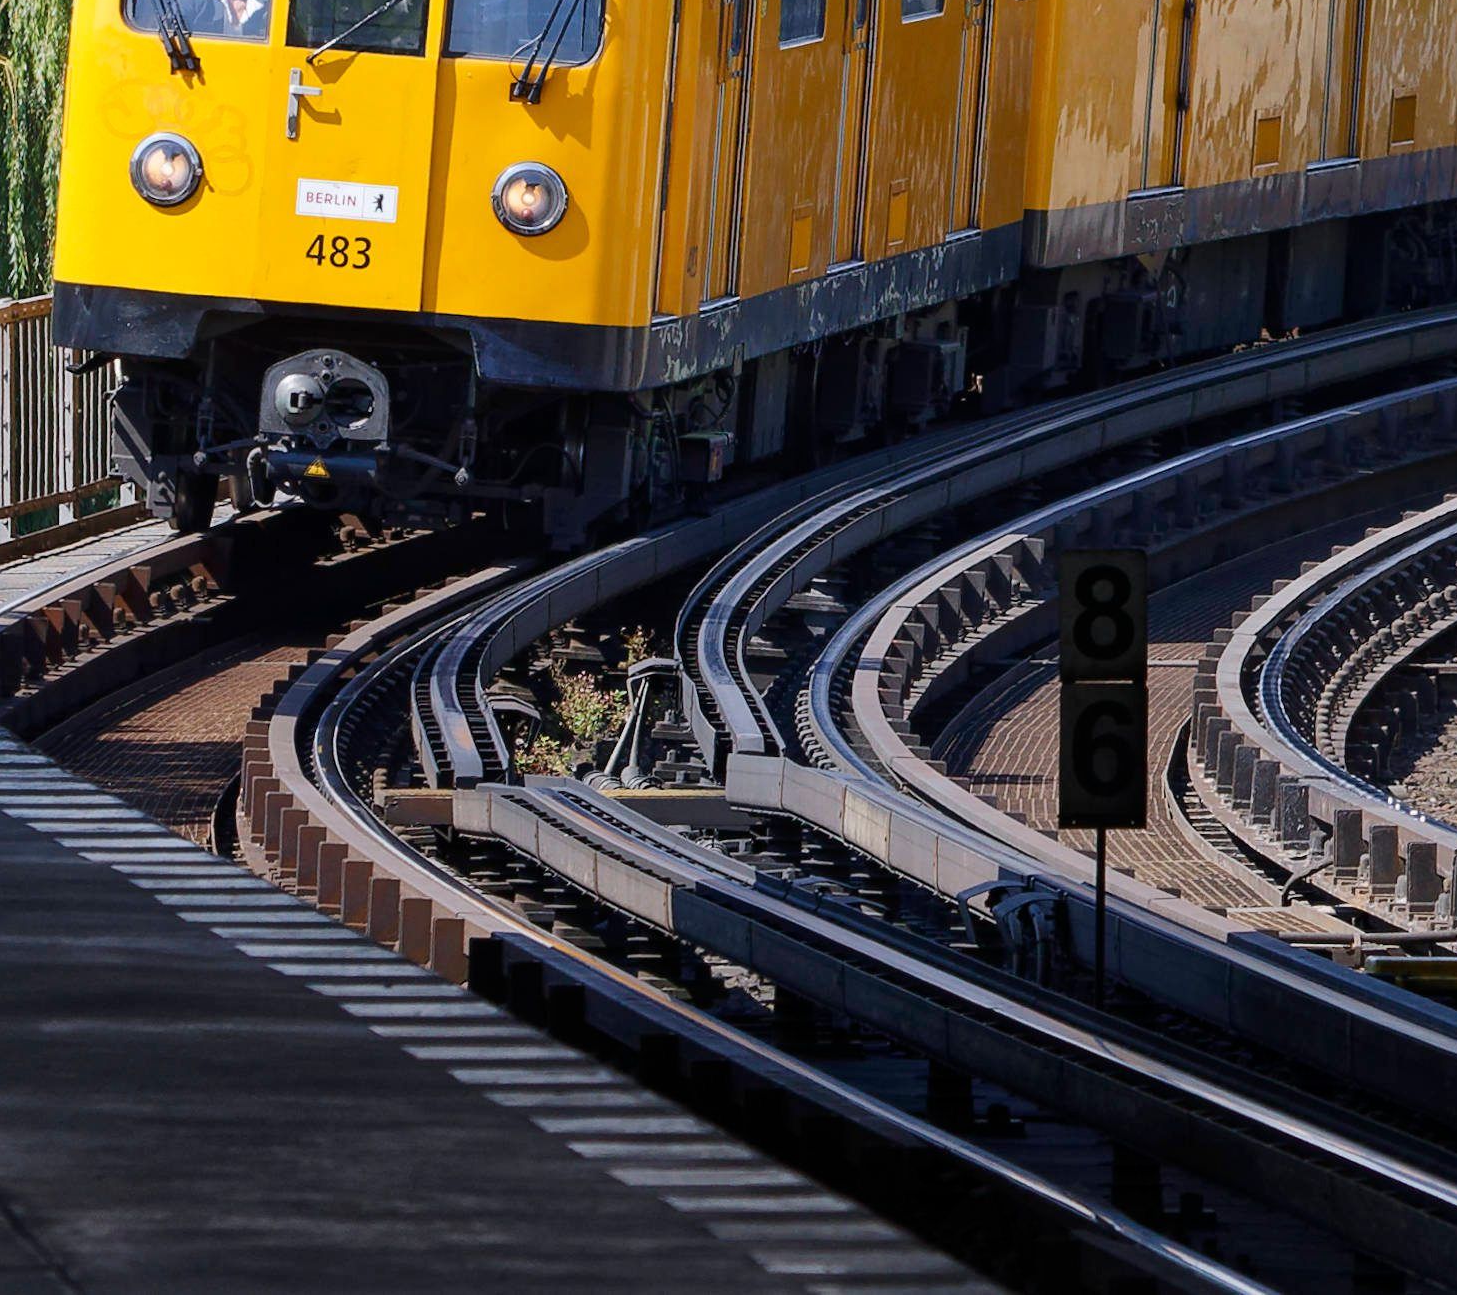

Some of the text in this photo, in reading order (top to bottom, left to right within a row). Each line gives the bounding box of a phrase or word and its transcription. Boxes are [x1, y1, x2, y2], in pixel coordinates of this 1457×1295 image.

[306, 192, 357, 207] BERLIN
[305, 234, 372, 270] 483
[1073, 565, 1135, 660] 8
[1072, 700, 1136, 798] 6
